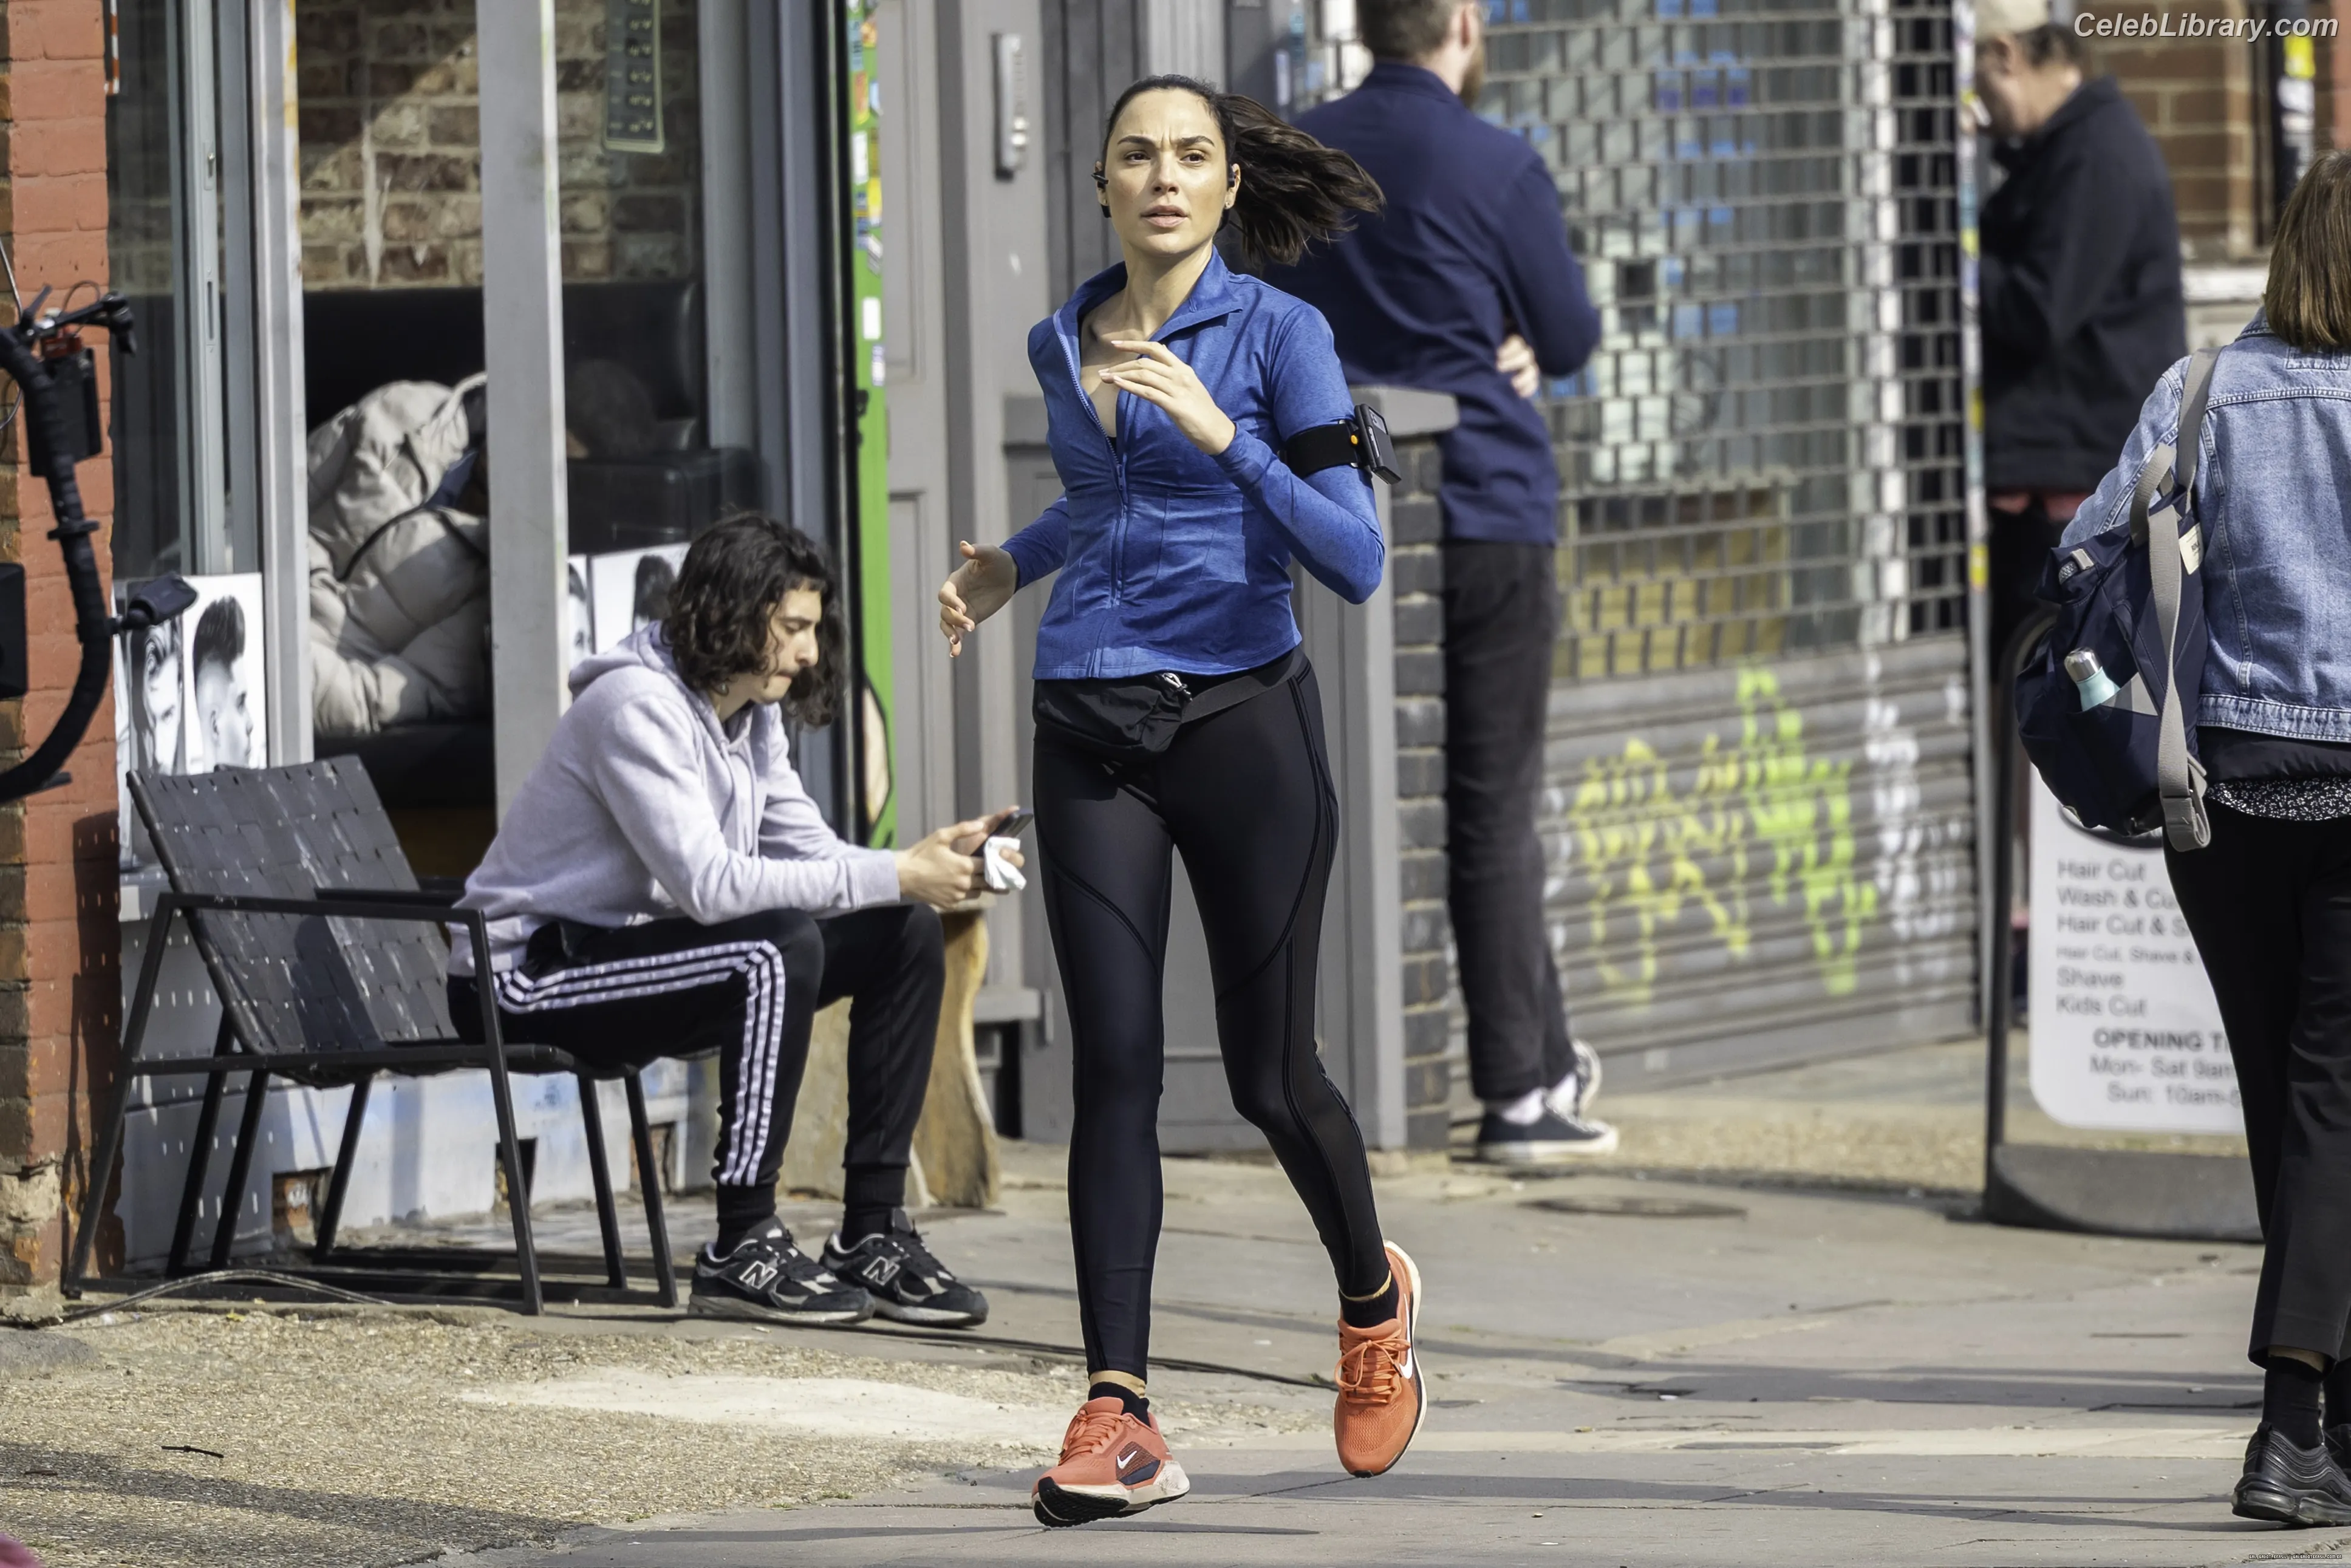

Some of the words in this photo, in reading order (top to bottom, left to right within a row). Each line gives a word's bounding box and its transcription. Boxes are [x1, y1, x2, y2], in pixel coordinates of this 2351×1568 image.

[2058, 859, 2101, 879] Hair
[2107, 859, 2146, 881] Cut
[2057, 886, 2117, 907] Wash
[2124, 887, 2140, 908] &
[2146, 887, 2179, 909] Cu
[2057, 914, 2100, 933] Hair
[2107, 915, 2145, 935] Cut
[2150, 915, 2165, 936] &
[2130, 947, 2177, 963] Shave
[2057, 966, 2124, 987] Shave
[2056, 995, 2103, 1015] Kids
[2109, 995, 2147, 1017] Cut
[2093, 1029, 2202, 1051] OPENING
[2152, 1057, 2187, 1077] Sat
